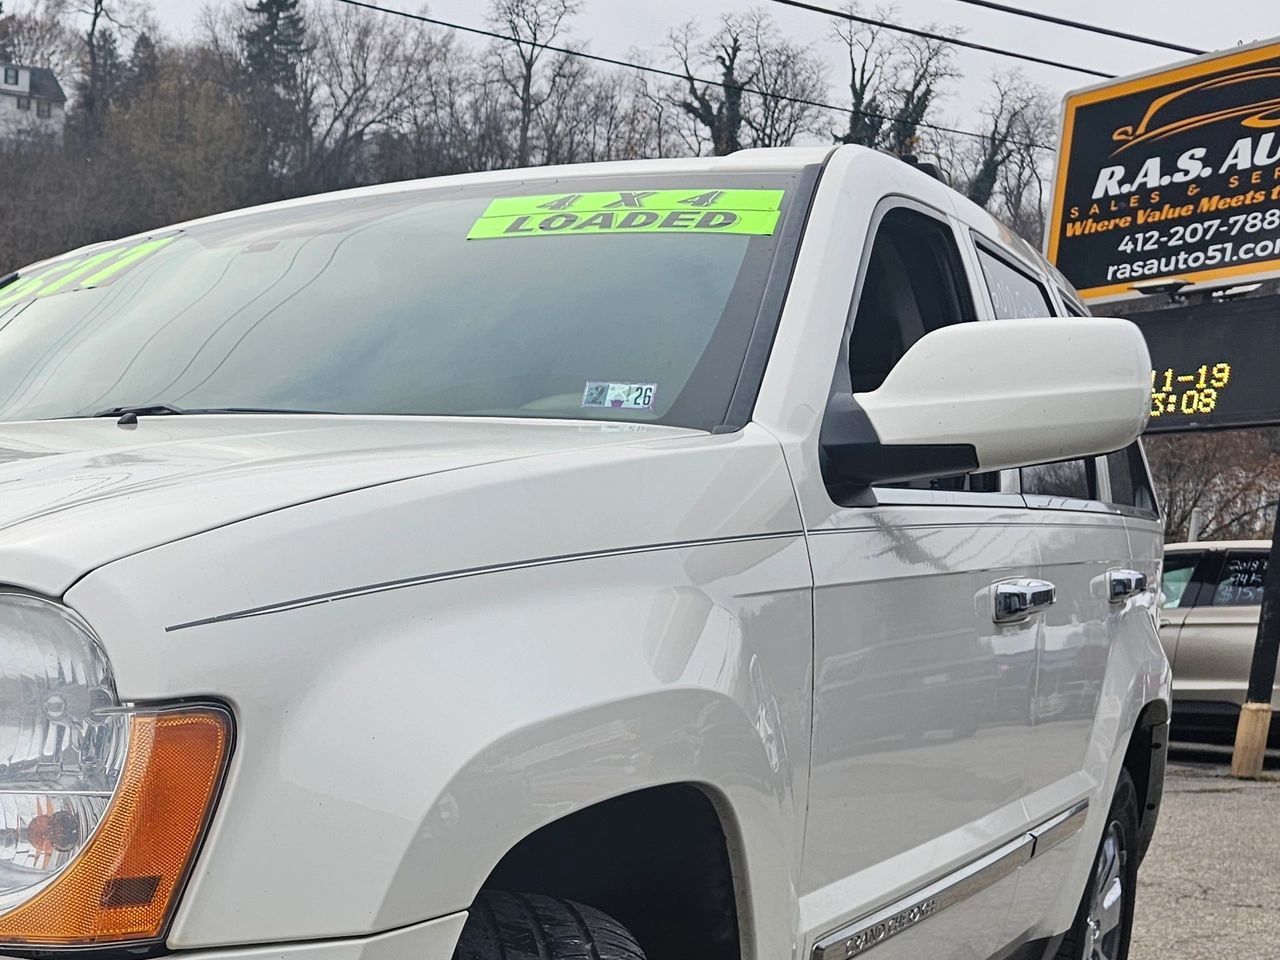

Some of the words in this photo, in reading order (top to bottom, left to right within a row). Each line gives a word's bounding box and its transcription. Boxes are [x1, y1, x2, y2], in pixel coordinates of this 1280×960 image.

[1091, 147, 1213, 200] R.A.S.
[536, 194, 582, 211] 4
[677, 190, 725, 209] 4
[1066, 213, 1132, 237] Where
[1136, 202, 1194, 226] Value
[1197, 189, 1266, 214] Meets
[1070, 191, 1161, 218] SALES
[1186, 183, 1201, 197] &
[502, 210, 742, 235] LOADED
[634, 386, 652, 405] 26
